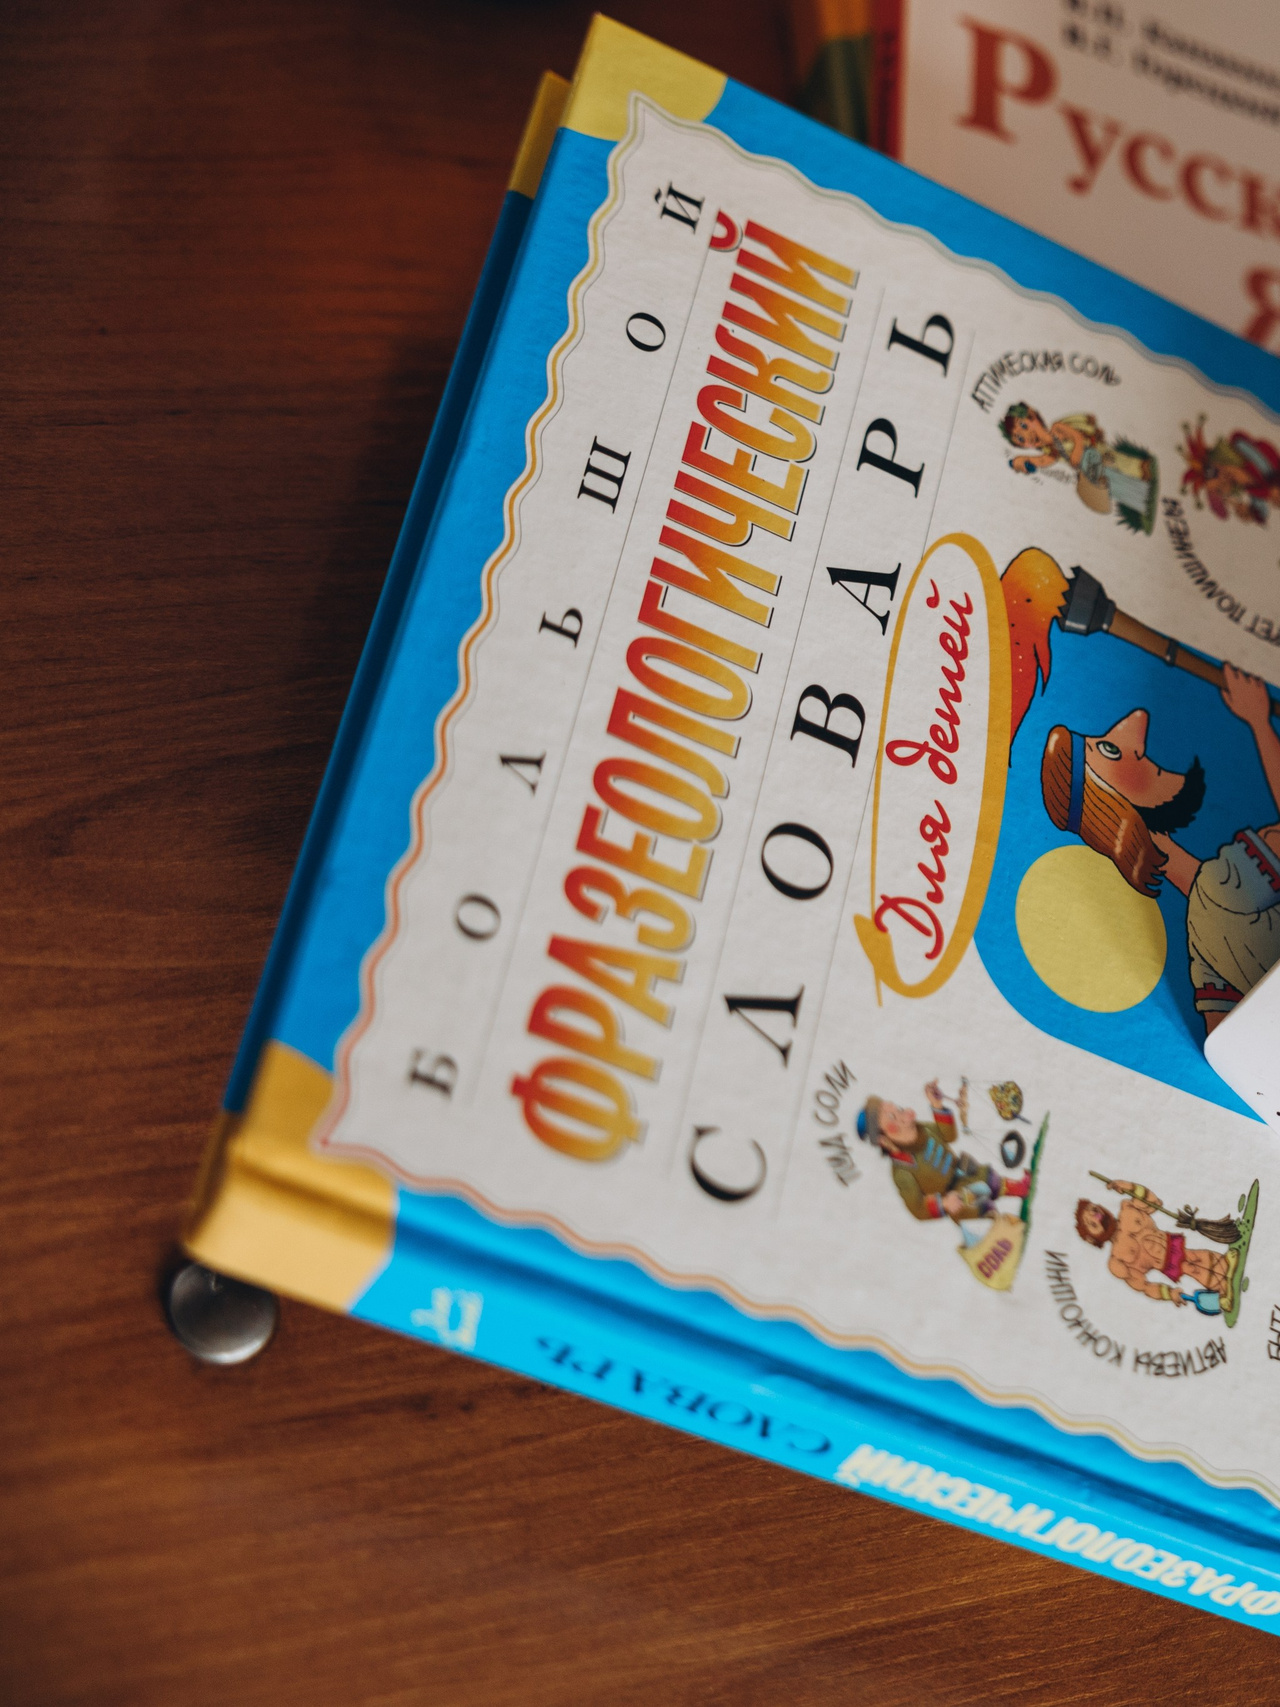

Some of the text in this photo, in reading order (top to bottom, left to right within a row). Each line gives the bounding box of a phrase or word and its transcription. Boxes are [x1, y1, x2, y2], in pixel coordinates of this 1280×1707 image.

[508, 207, 859, 1164] ФРАЗЕОЛОГИЧЕСКИЙ
[690, 311, 955, 1201] СЛОВАРЬ
[875, 578, 974, 960] Для детей
[814, 1059, 857, 1127] СОЛИ
[534, 1332, 831, 1458] СЛОВАРЬ
[1044, 1249, 1227, 1377] АВГИЕВЫ КОНЮШНИ
